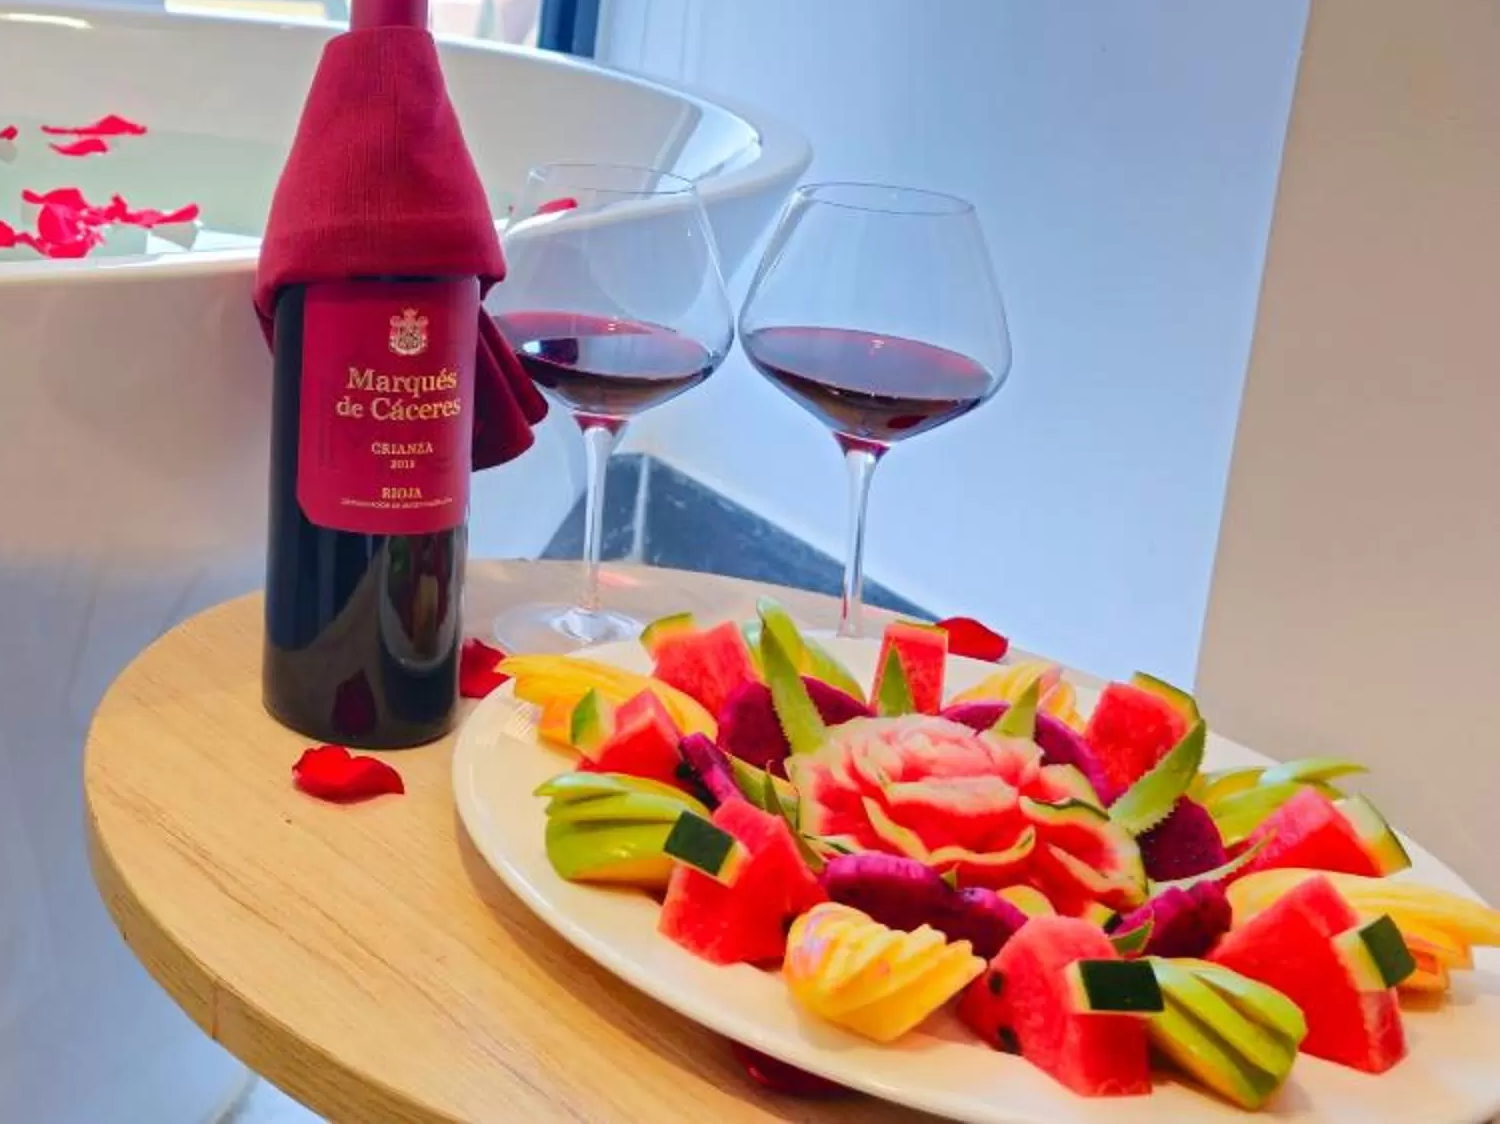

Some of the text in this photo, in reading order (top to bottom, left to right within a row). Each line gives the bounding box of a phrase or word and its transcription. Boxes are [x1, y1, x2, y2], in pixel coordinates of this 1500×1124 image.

[347, 367, 458, 397] Marqués
[336, 396, 461, 421] de Cáceres
[371, 441, 433, 455] CRIANZA
[382, 487, 422, 499] RIOJA
